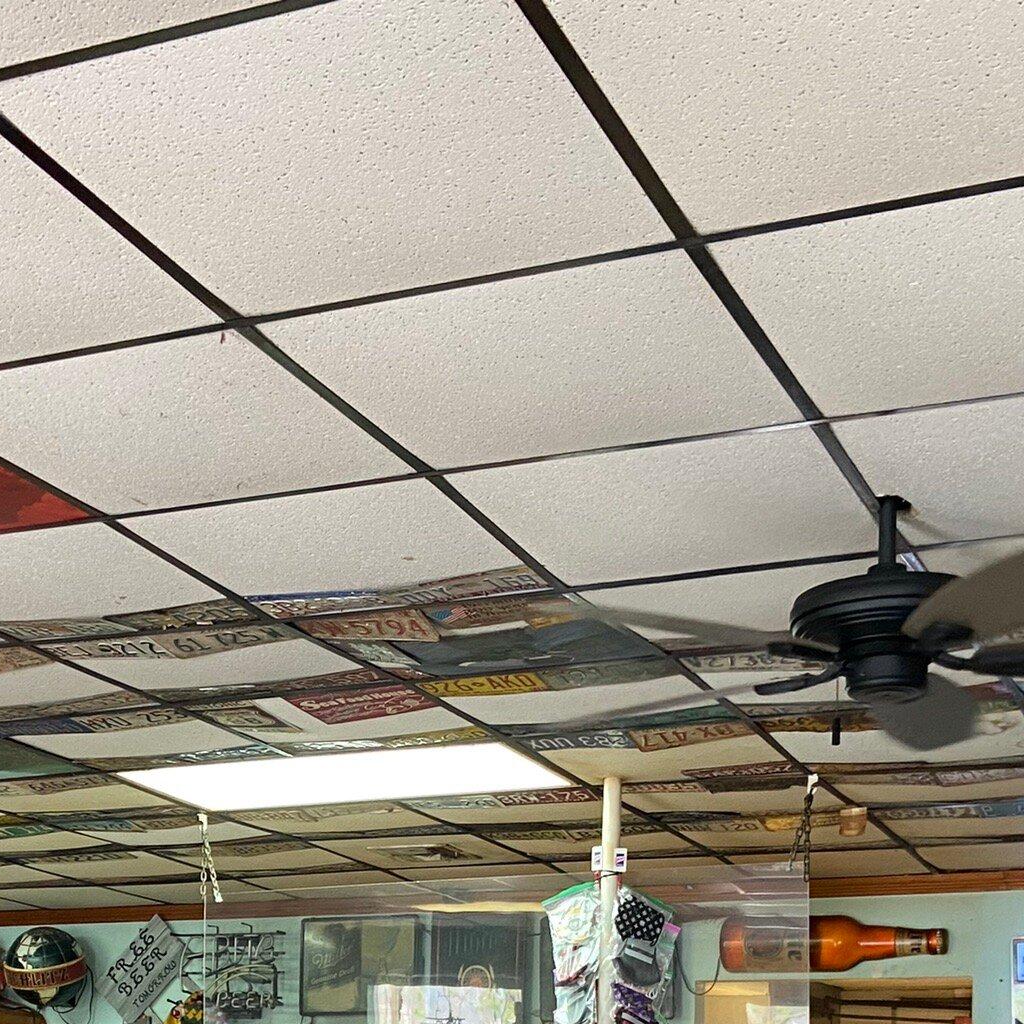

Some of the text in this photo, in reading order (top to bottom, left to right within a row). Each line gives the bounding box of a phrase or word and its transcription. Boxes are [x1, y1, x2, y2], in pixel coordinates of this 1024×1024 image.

[106, 928, 155, 984] FREE
[118, 946, 168, 997] BEER
[132, 960, 178, 1009] TOMORROW
